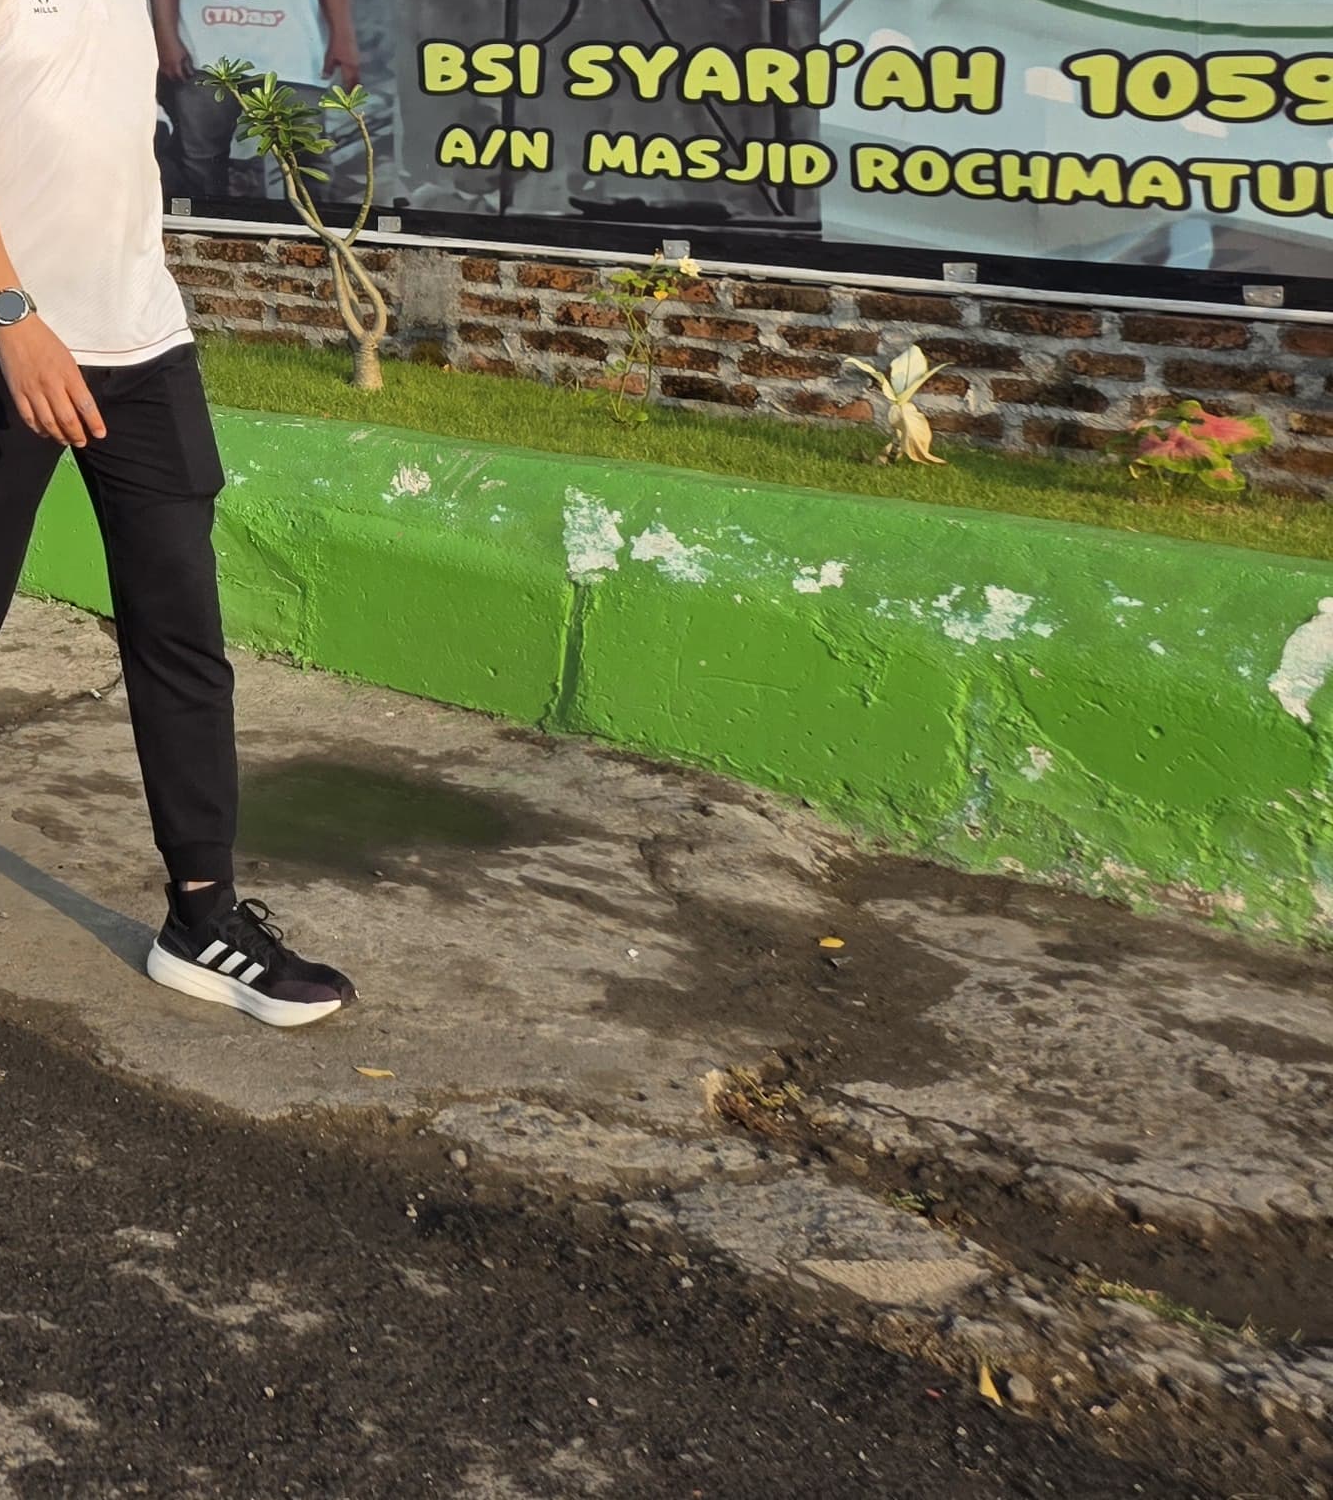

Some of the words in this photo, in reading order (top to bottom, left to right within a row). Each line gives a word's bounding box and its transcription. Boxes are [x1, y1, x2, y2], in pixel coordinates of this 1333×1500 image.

[420, 40, 543, 97] BSI
[565, 41, 1004, 112] SYARI'AH
[1063, 50, 1333, 125] 1059
[437, 126, 553, 171] A/N
[586, 131, 837, 187] MASJID
[853, 143, 1333, 218] ROCHMATU
